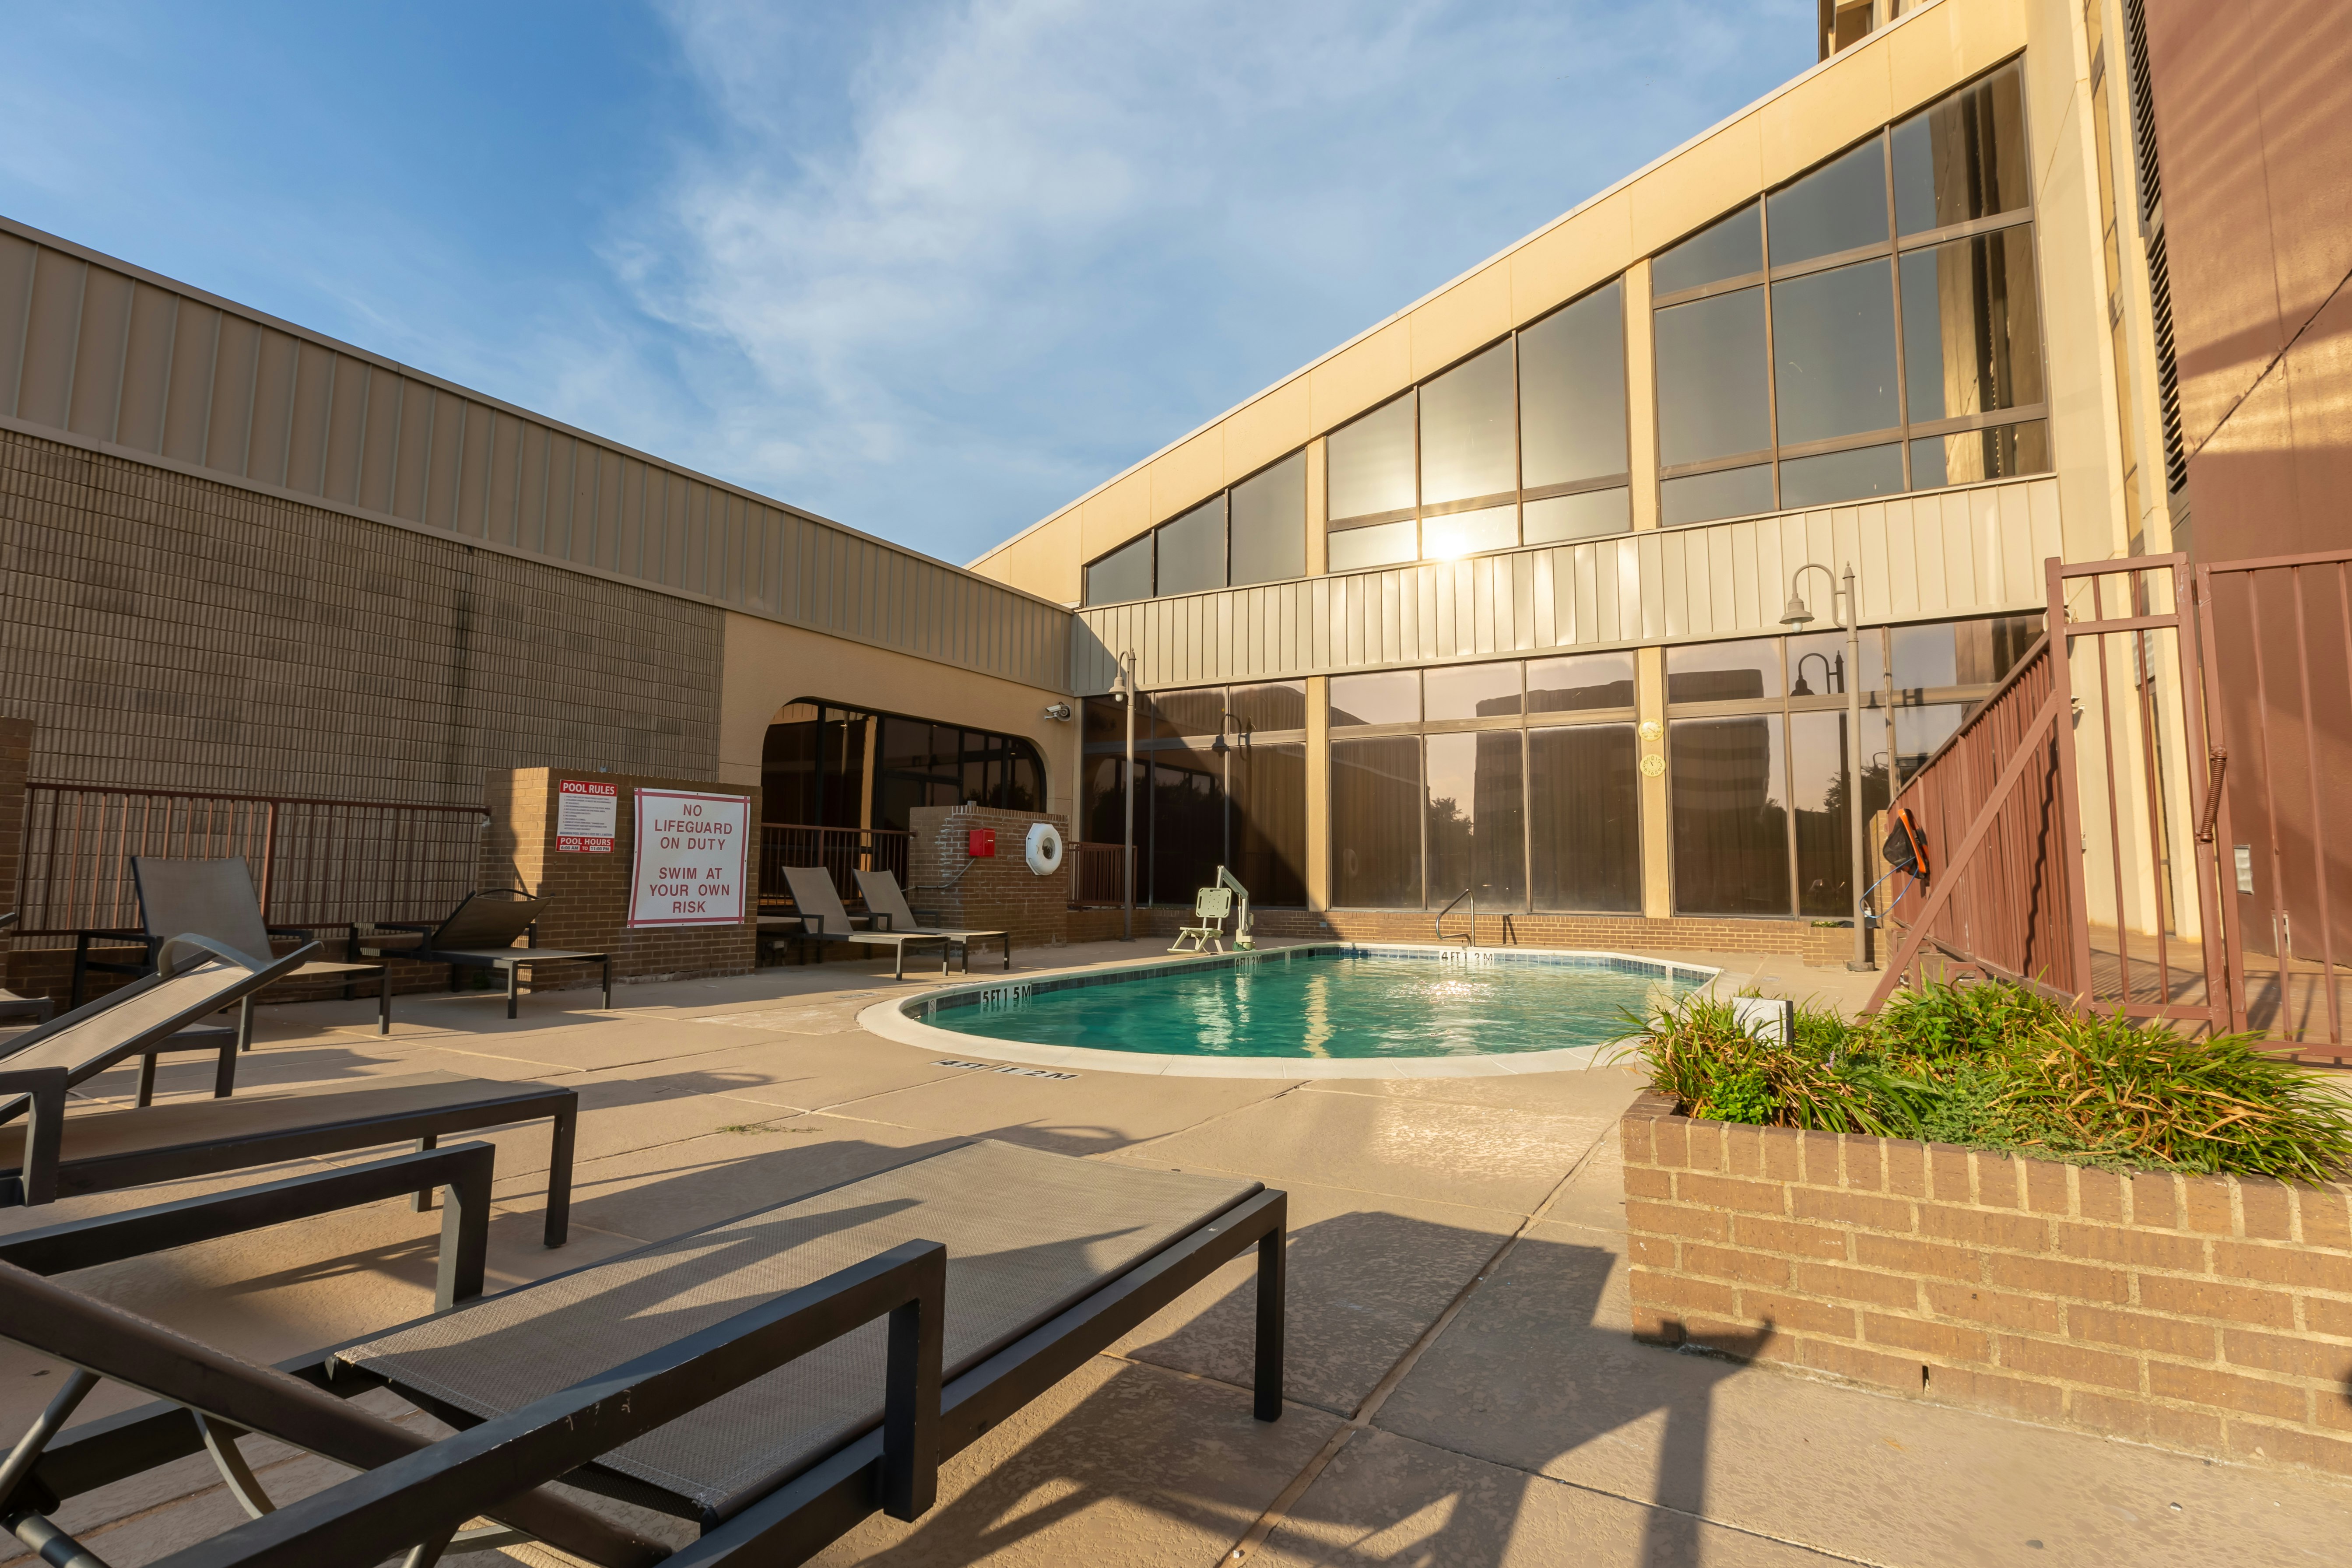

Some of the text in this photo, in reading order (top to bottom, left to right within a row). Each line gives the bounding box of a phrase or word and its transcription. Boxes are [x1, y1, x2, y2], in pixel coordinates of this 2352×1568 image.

[563, 782, 615, 795] POOL RULES
[683, 804, 702, 817] NO
[655, 819, 733, 835] LIFEGUARD
[660, 836, 726, 850] ON DUTY
[659, 867, 722, 879] SWIM AT
[649, 884, 730, 896] YOUR OWN
[673, 901, 706, 913] RISK
[1240, 958, 1246, 966] FT
[1252, 956, 1255, 965] 2
[1257, 956, 1261, 965] M
[983, 985, 1031, 1003] 5 FT 1 5 M
